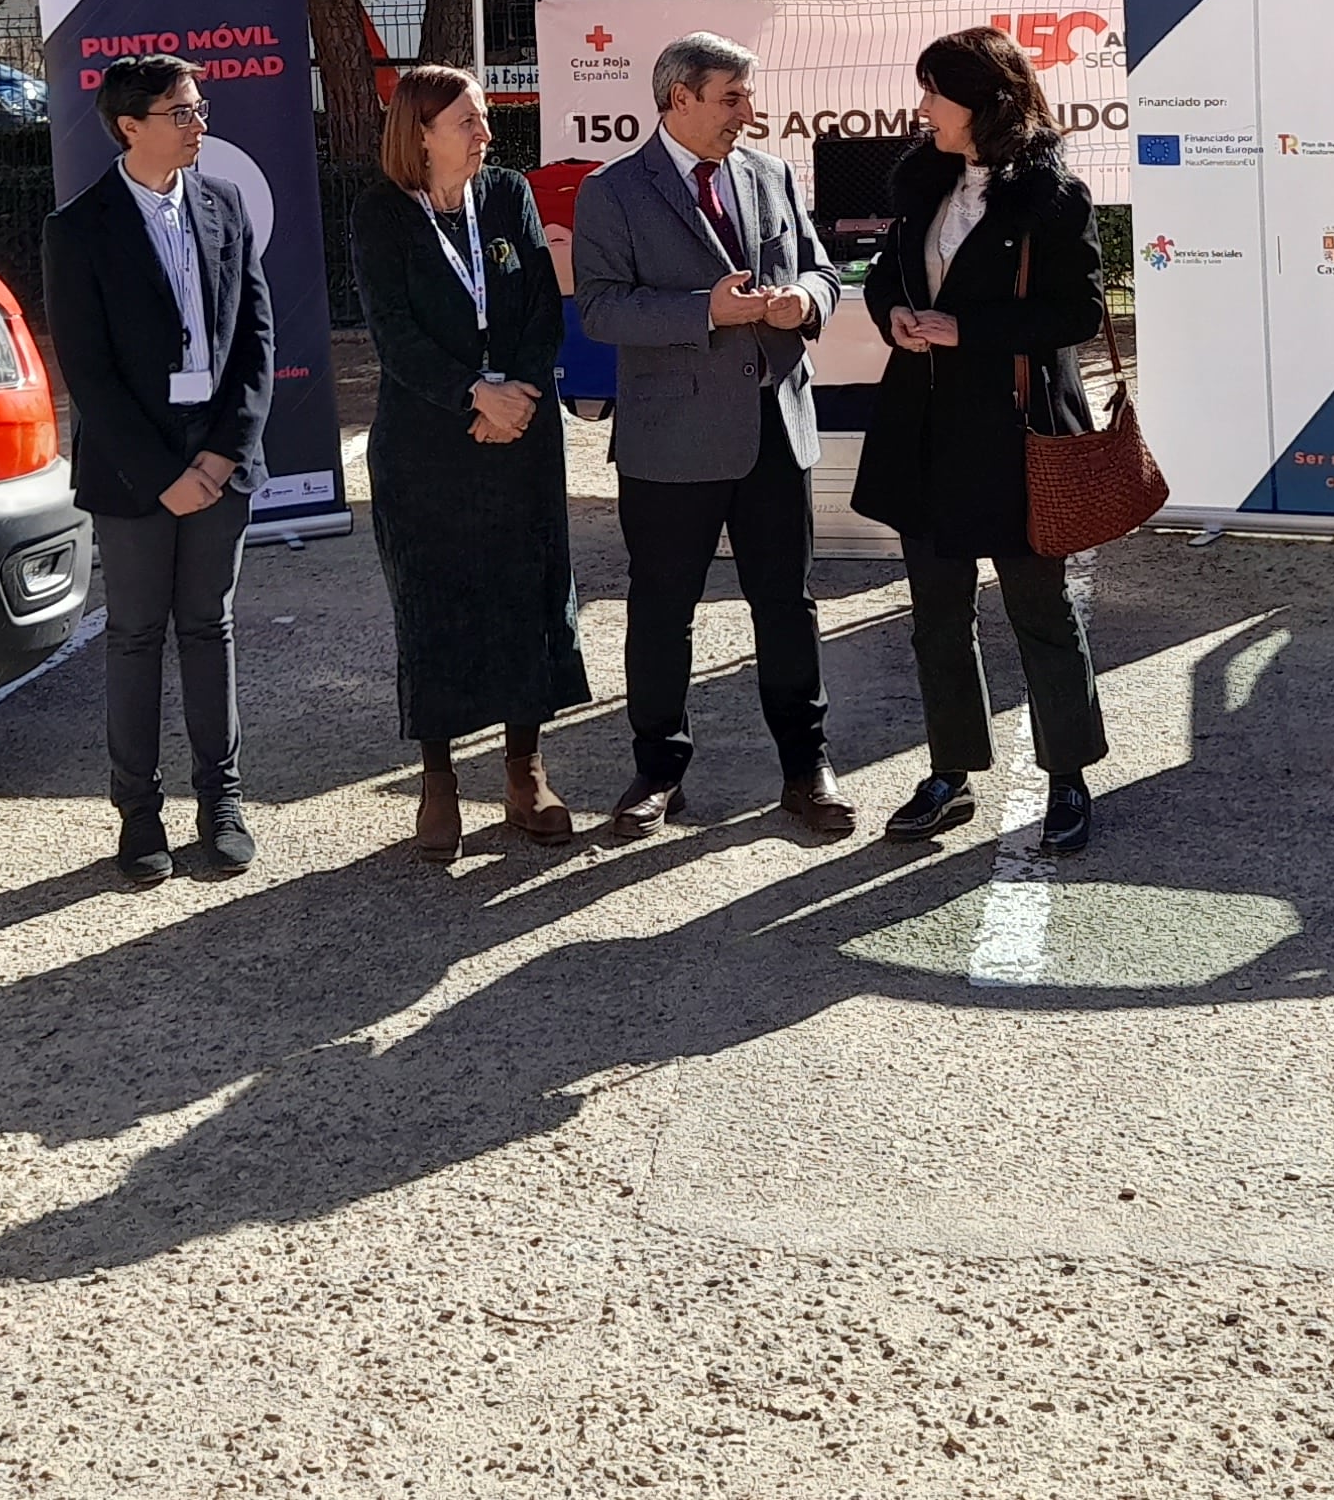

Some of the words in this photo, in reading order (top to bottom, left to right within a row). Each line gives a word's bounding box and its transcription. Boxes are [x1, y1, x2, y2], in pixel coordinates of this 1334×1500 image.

[81, 32, 179, 59] PUNTO
[188, 23, 279, 50] MÓVIL
[196, 56, 284, 80] VIDAD
[571, 58, 599, 68] Cruz
[603, 56, 630, 69] Roja
[573, 70, 629, 82] Española
[1138, 97, 1201, 107] Financiado
[1204, 99, 1228, 108] por:
[573, 114, 639, 143] 150
[1185, 134, 1235, 142] Financiado
[1238, 135, 1253, 143] por
[1195, 146, 1223, 154] Unión
[1225, 145, 1264, 154] Europea
[1174, 250, 1209, 258] Servicios
[1211, 250, 1243, 258] Sociales
[1294, 451, 1325, 465] Ser
